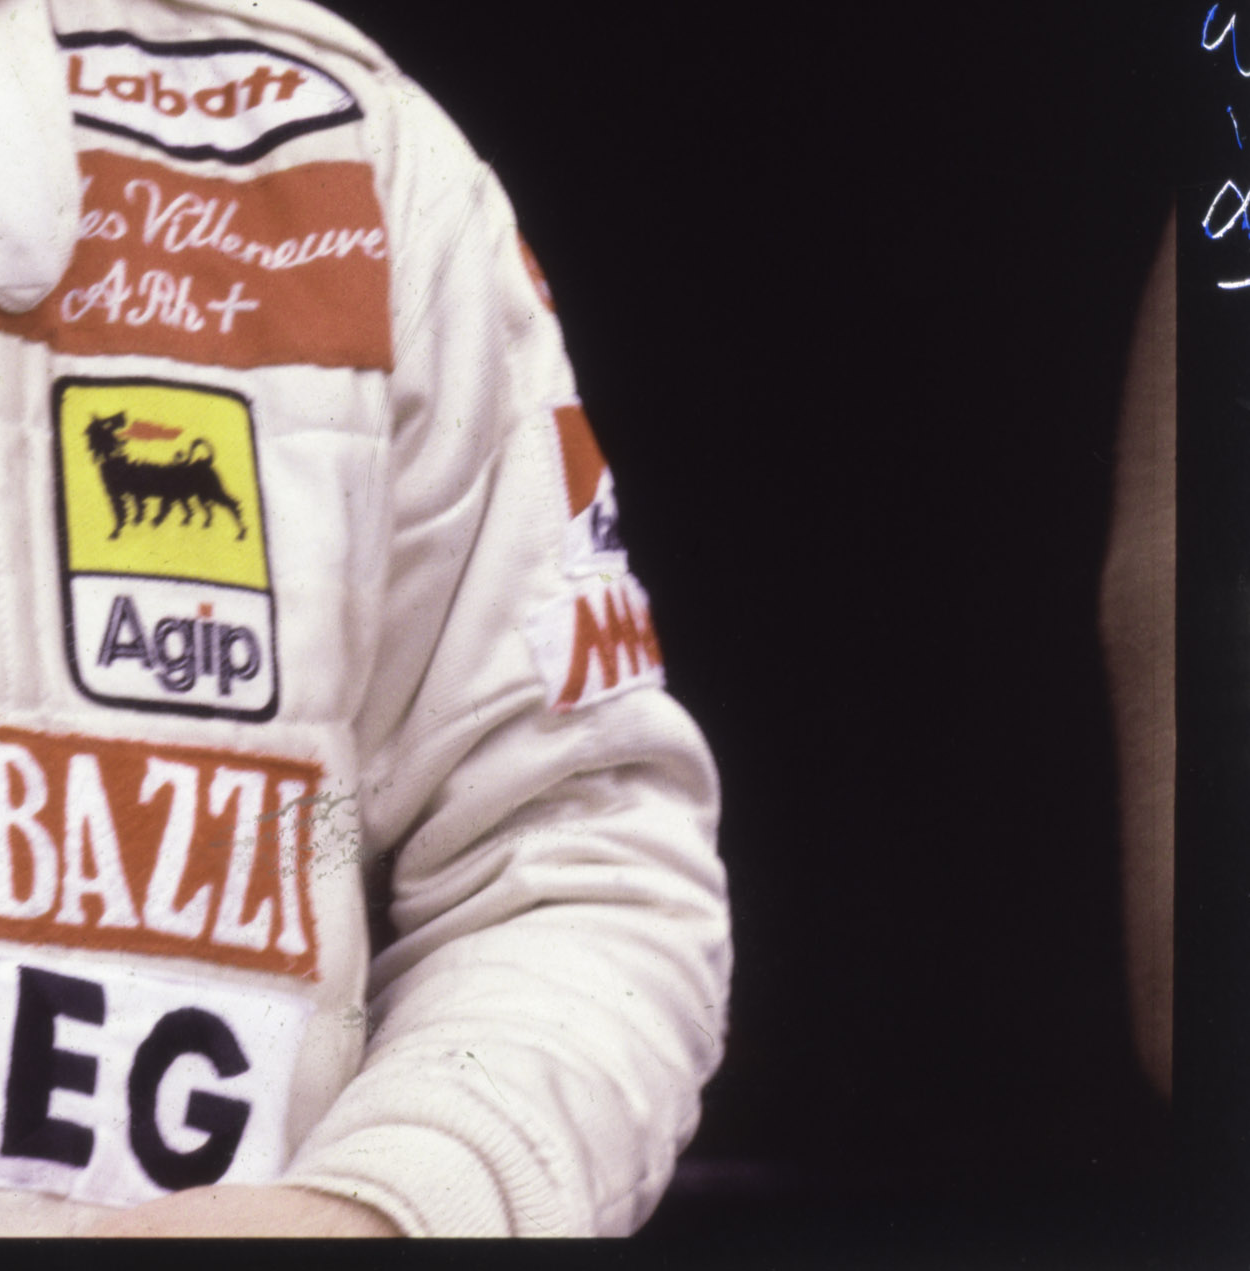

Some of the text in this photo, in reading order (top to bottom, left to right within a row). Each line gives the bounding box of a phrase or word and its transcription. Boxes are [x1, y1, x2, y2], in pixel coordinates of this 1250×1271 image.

[67, 54, 308, 119] Labatt
[80, 175, 388, 271] es Villeneuve
[96, 596, 261, 696] Agip
